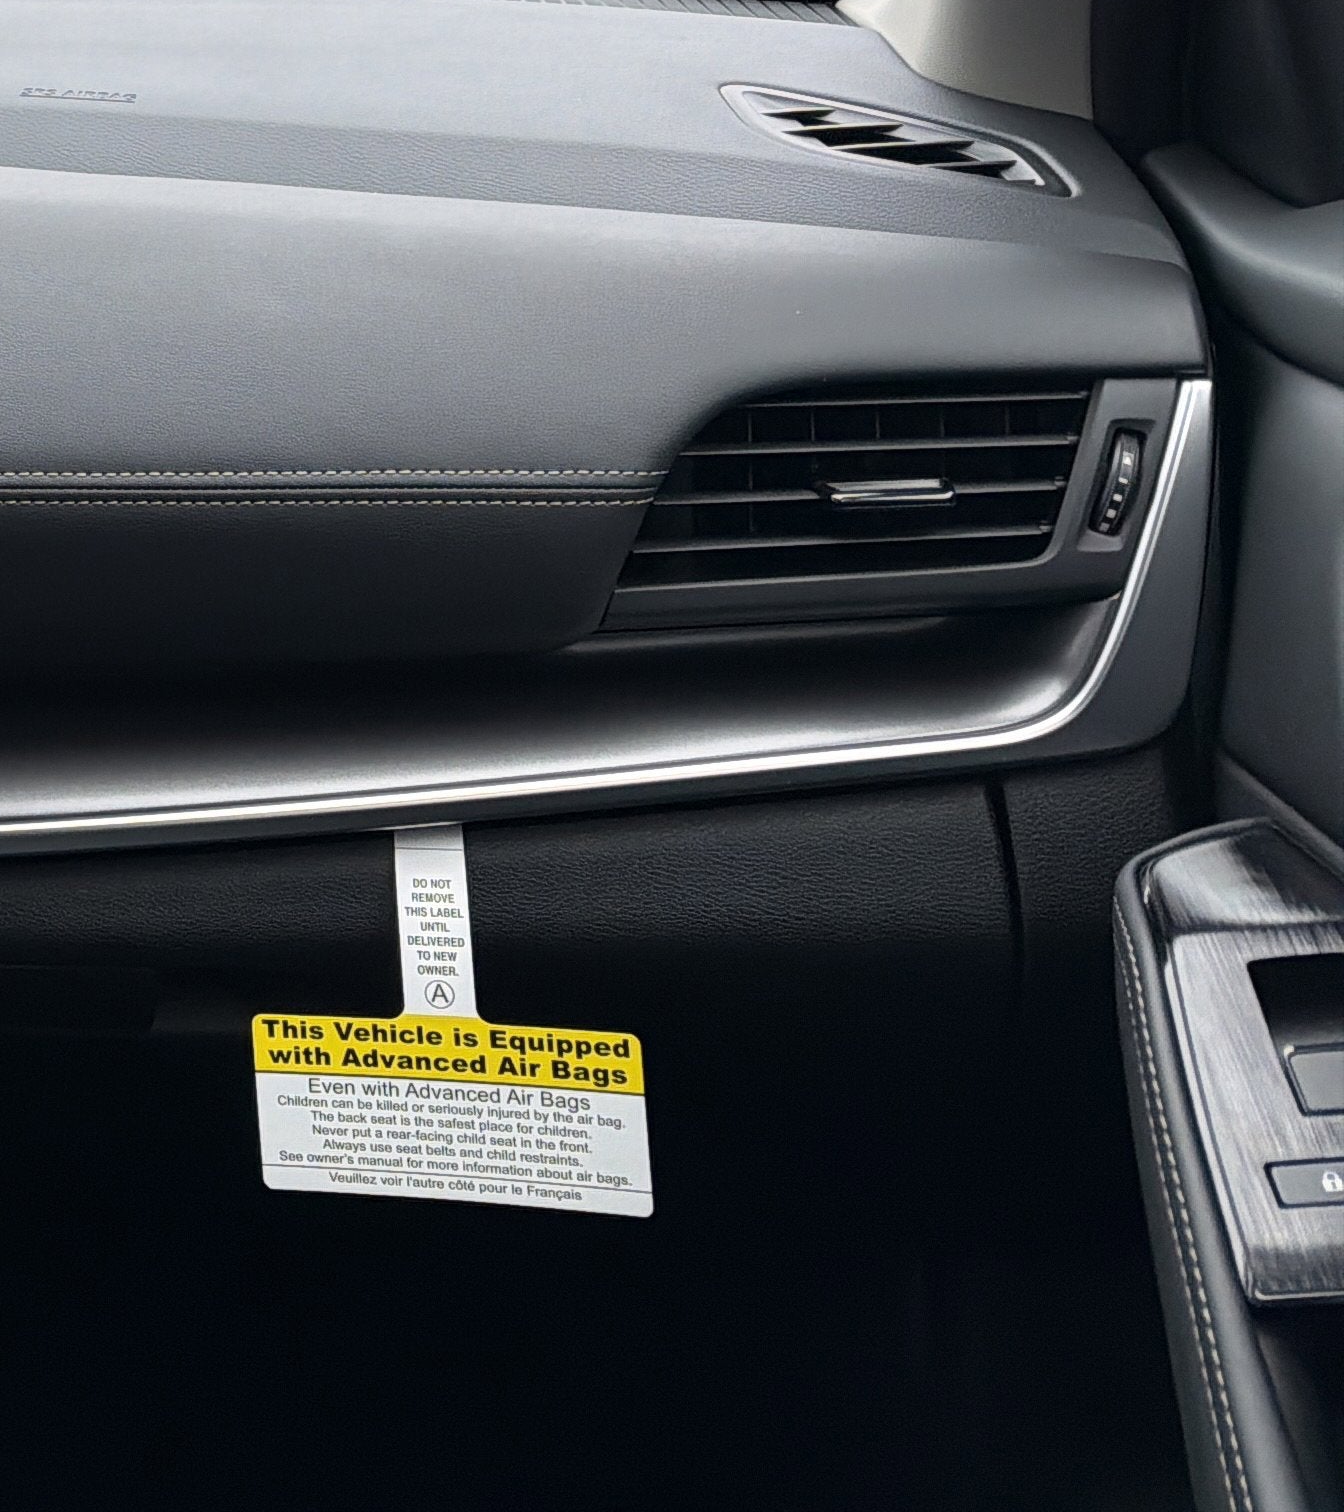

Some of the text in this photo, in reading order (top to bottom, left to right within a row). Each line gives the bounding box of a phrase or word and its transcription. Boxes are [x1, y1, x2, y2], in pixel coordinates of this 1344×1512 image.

[411, 892, 455, 904] REMOVE
[412, 878, 452, 889] DO NOT
[404, 906, 464, 919] THIS LABEL
[420, 921, 451, 933] UNTIL
[407, 935, 465, 948] DELIVERED
[416, 950, 458, 962] TO NEW
[417, 964, 460, 977] OWNER.
[262, 1019, 630, 1060] This Vehicle is Equipped
[268, 1046, 628, 1088] with Advanced Air Bags
[308, 1077, 591, 1113] Even with Advanced Air Bags
[277, 1094, 627, 1131] Children can be killed or seriously injured by the air bag.
[310, 1110, 592, 1140] The back seat is the safest place for children.
[311, 1124, 593, 1154] Never put a rear-facing child seat in the front.
[322, 1138, 584, 1167] Always use seat belts and child restraints.
[279, 1150, 633, 1188] See owner's manual for more information about air bags.
[328, 1171, 583, 1201] Veuillez voir l'autre côté pour le Français
